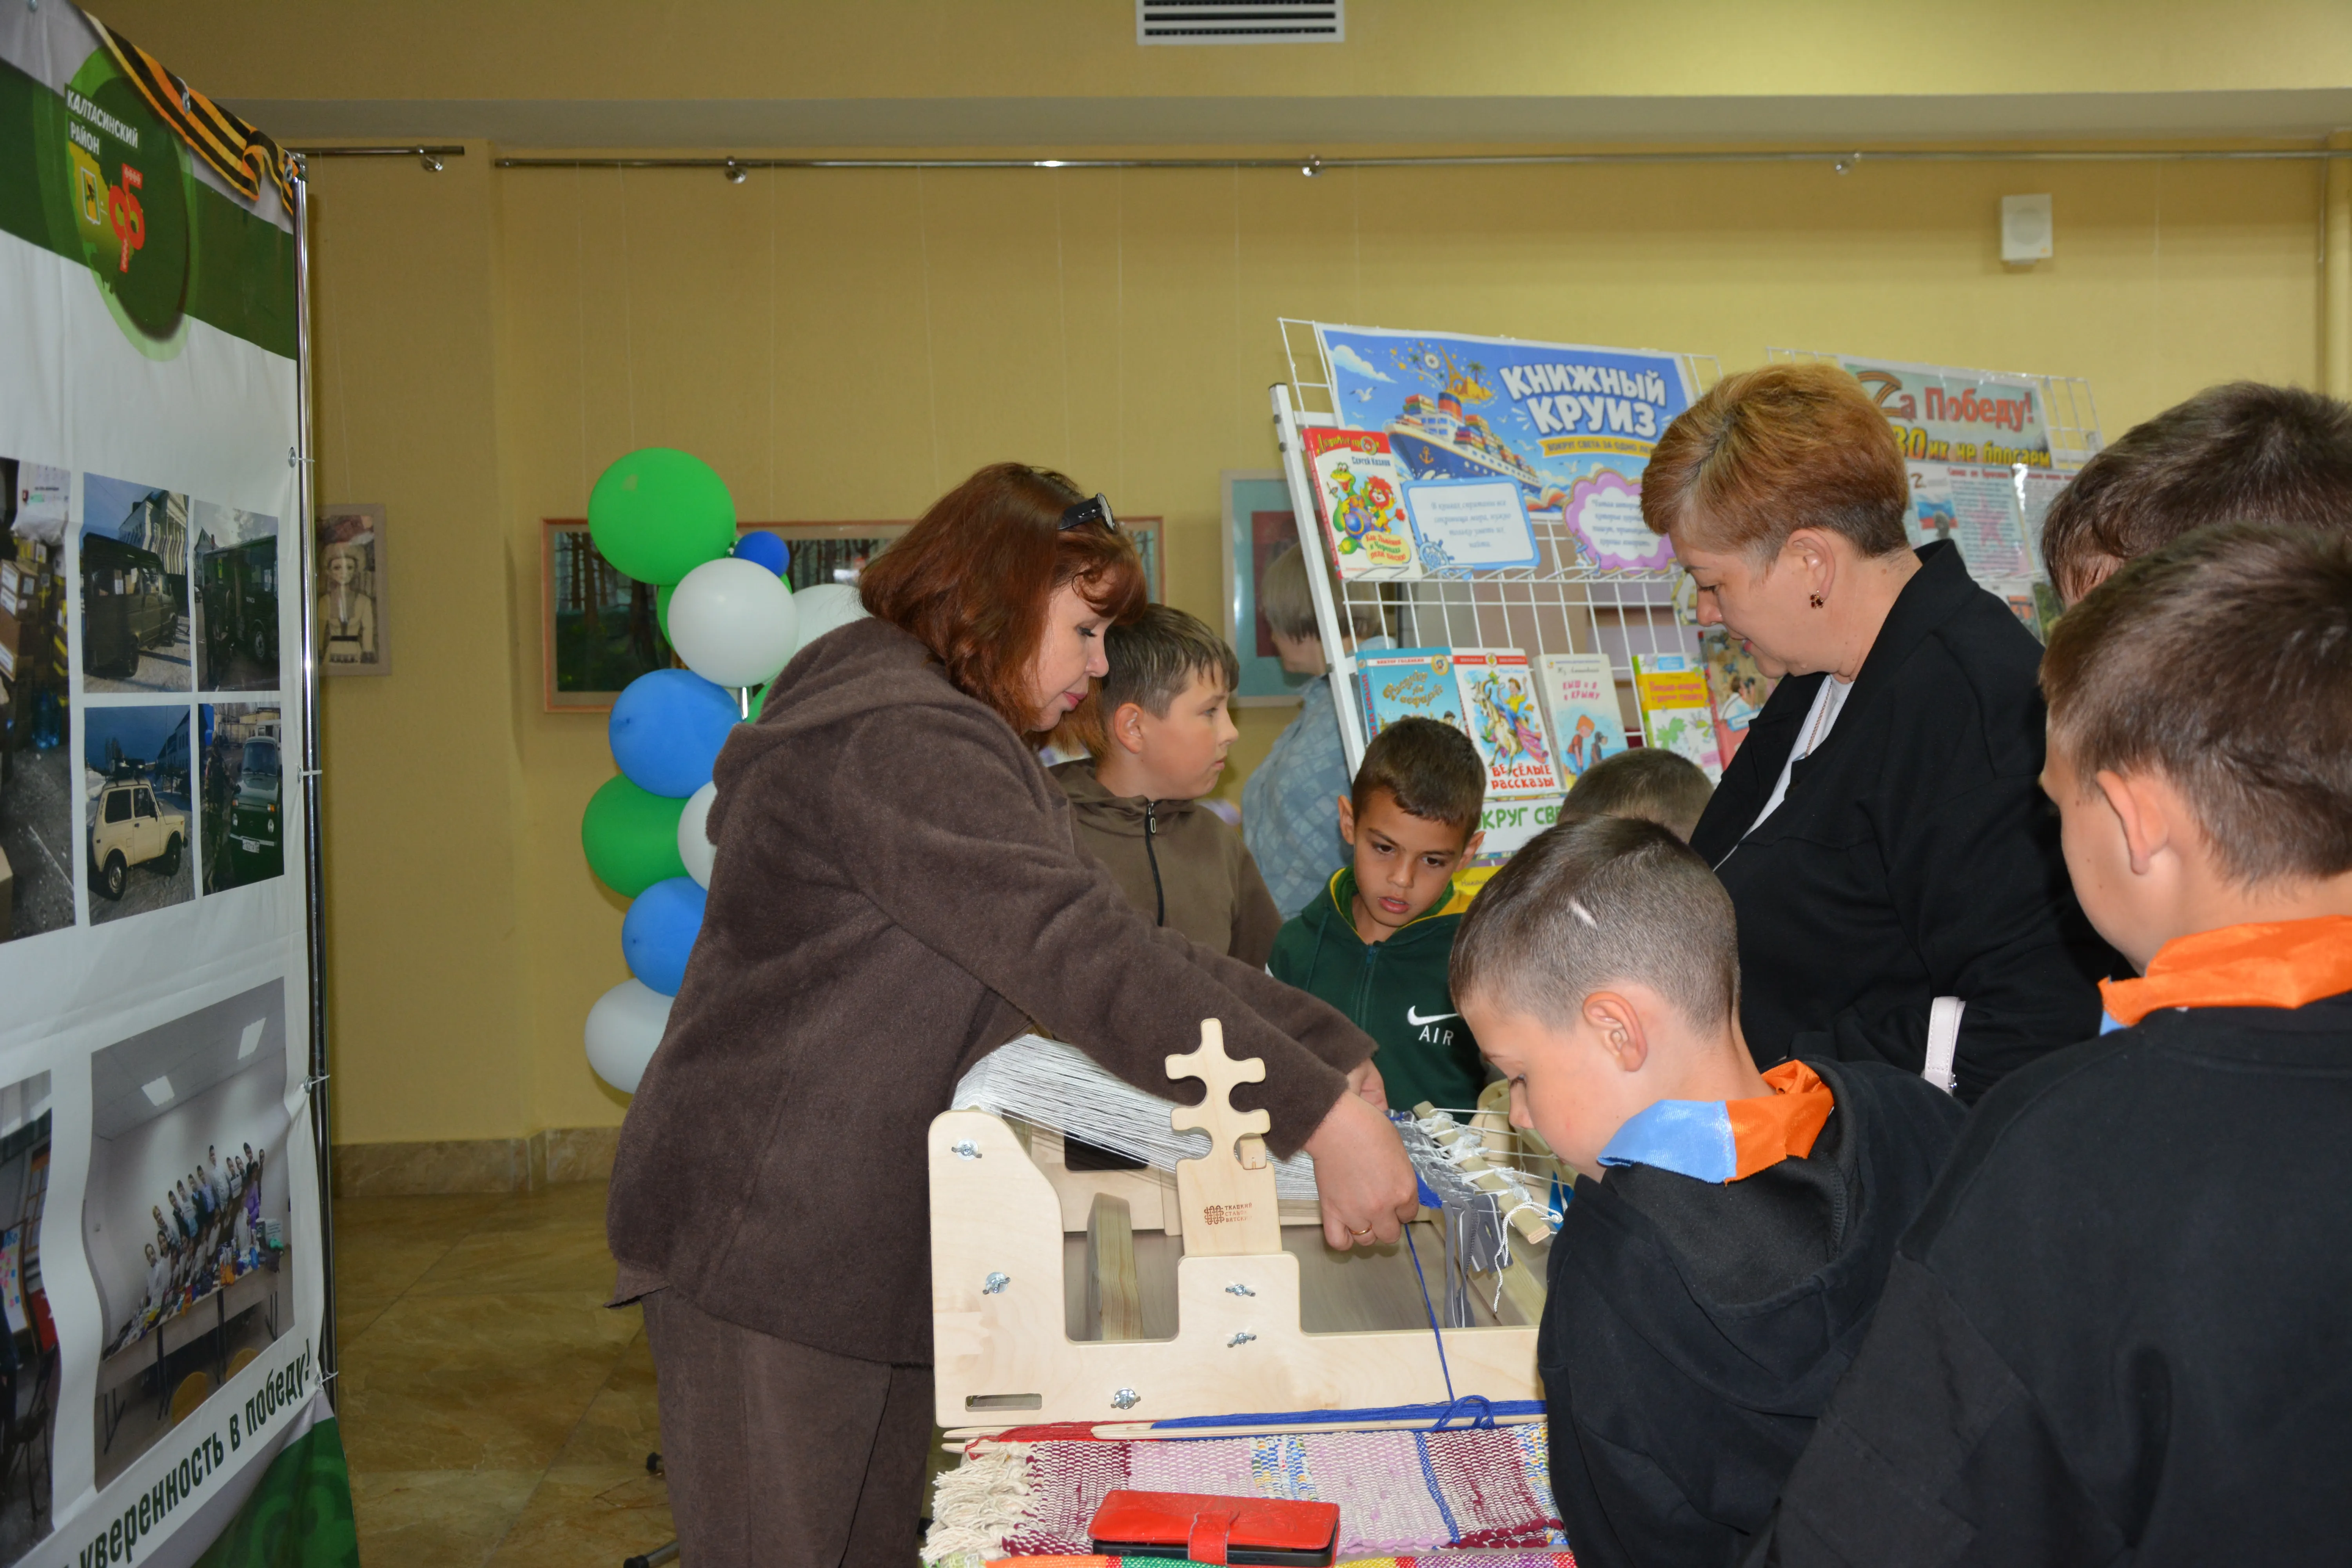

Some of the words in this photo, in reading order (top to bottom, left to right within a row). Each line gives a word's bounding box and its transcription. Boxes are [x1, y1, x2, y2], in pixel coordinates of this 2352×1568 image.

[67, 89, 138, 149] КАЛТАСИНСКИЙ
[71, 121, 99, 155] РАЙОН
[1499, 364, 1665, 406] КНИЖНЫЙ
[1527, 395, 1657, 437] КРУИЗ
[1925, 387, 2034, 432] Победу!
[1578, 440, 1601, 448] СВЕТА
[1476, 807, 1528, 830] КРУГ
[1534, 806, 1562, 824] СВЕ
[1418, 1025, 1454, 1046] AIR
[230, 1413, 241, 1452] в
[245, 1338, 310, 1437] победу!
